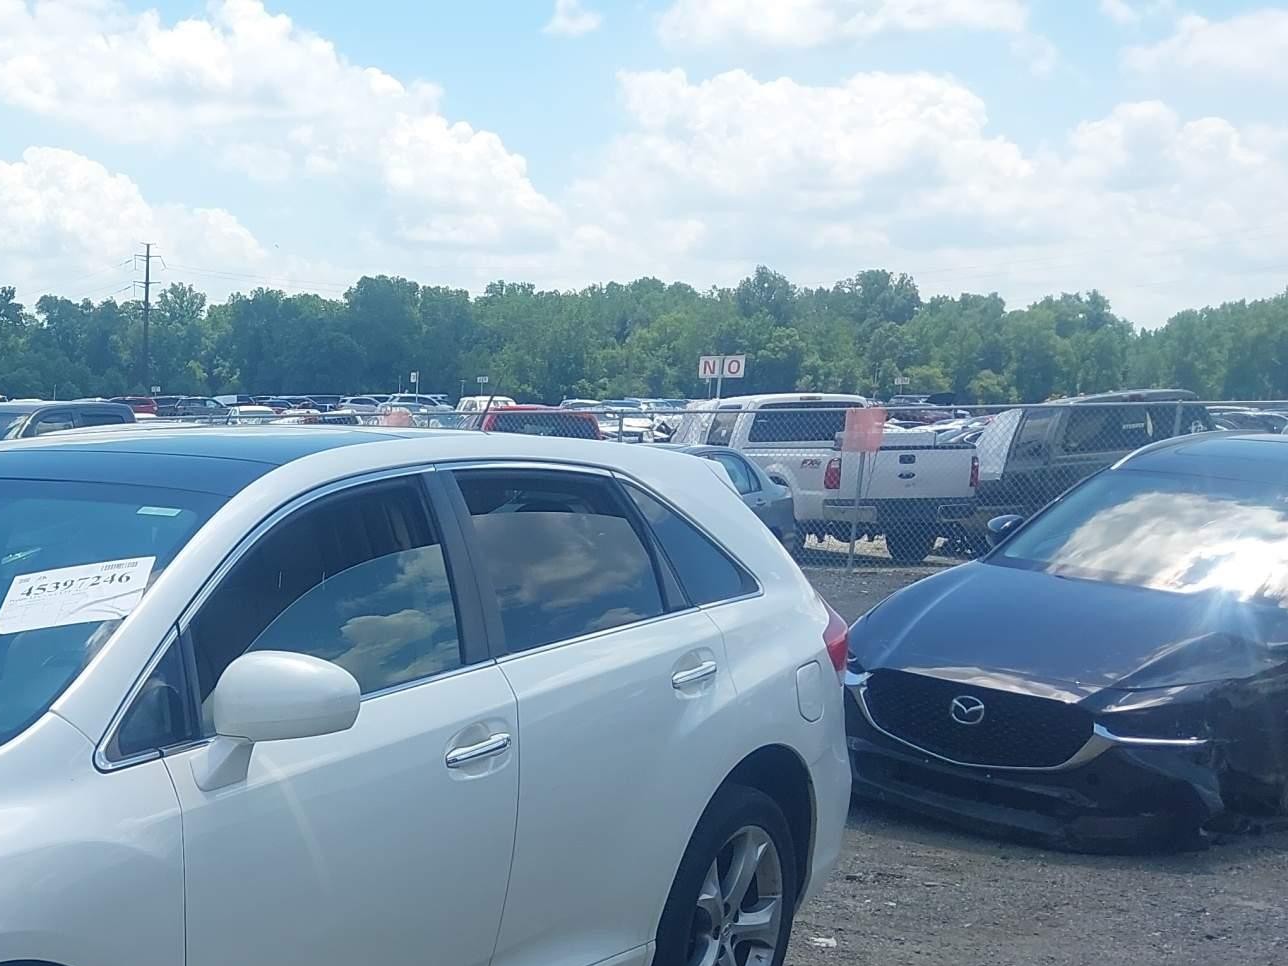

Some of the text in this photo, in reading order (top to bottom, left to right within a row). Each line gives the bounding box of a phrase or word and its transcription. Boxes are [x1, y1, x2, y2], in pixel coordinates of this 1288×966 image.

[703, 359, 741, 375] N O
[21, 571, 131, 597] 45397246
